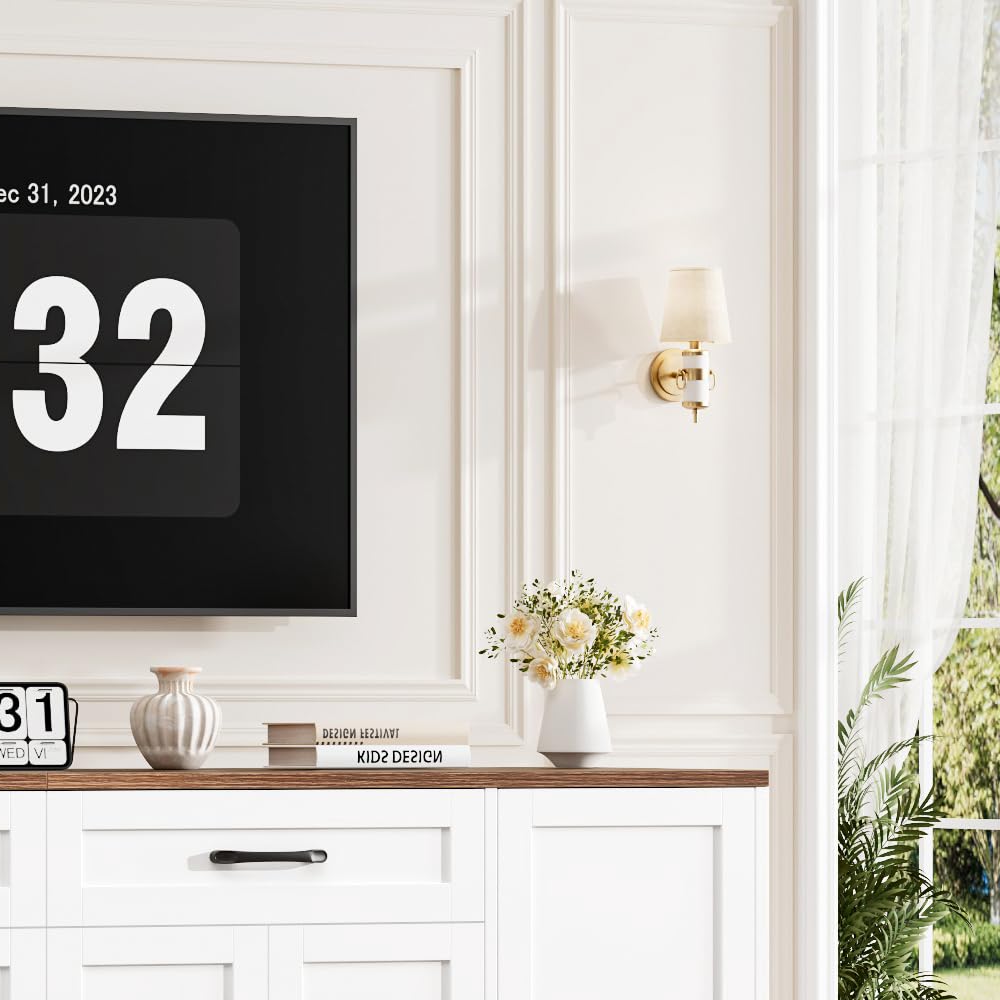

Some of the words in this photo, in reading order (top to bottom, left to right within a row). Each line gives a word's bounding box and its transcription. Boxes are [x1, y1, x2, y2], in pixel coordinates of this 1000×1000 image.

[27, 182, 58, 207] 31,
[68, 183, 118, 206] 2023
[12, 275, 206, 453] 32
[33, 747, 47, 759] VI
